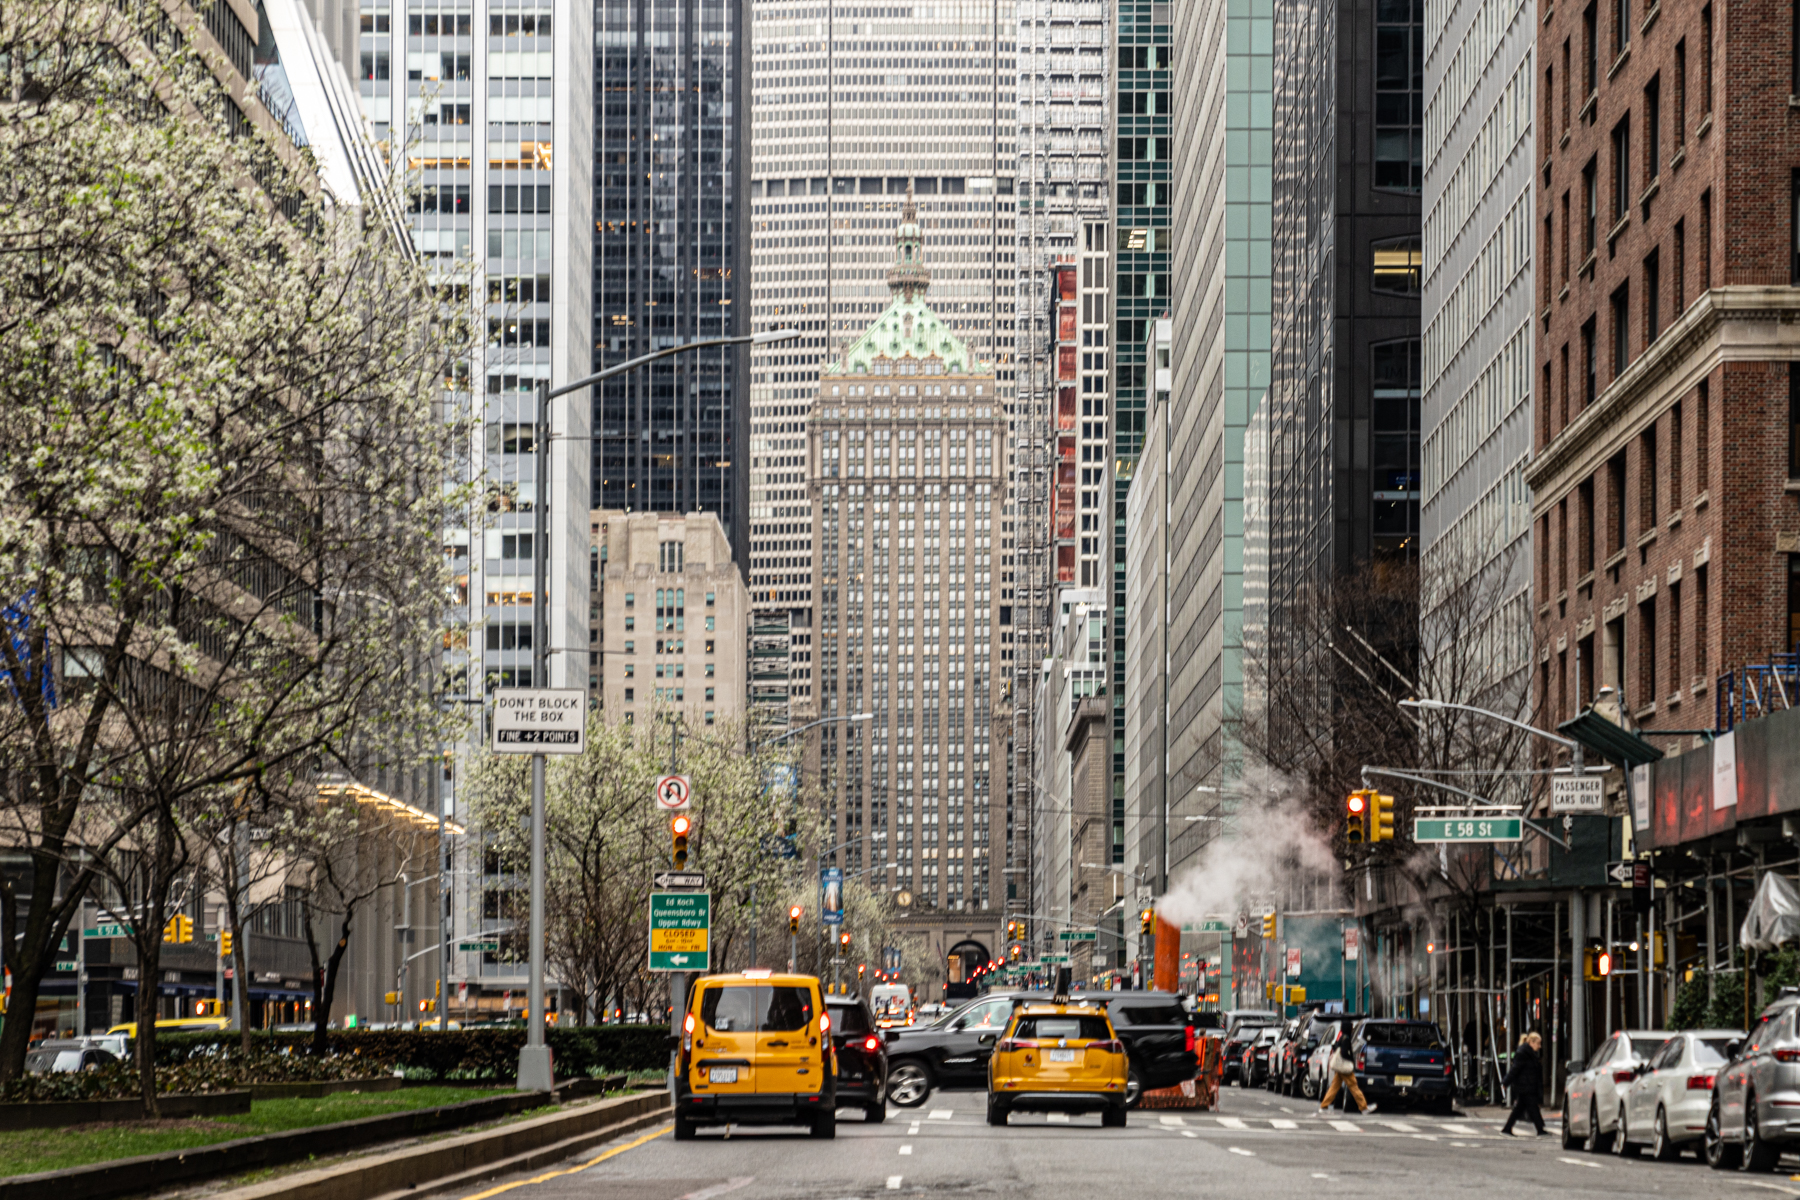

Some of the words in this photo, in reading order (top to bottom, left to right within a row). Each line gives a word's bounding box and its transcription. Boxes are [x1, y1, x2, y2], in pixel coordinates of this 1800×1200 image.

[499, 697, 535, 709] DON'T
[538, 697, 578, 709] BLOCK
[514, 711, 536, 722] THE
[540, 711, 563, 722] BOX
[500, 730, 521, 742] FINE
[542, 730, 576, 743] POINTS
[1555, 781, 1600, 792] PASSENGER
[1555, 794, 1576, 805] CARS
[1580, 794, 1600, 805] ONLY
[1444, 822, 1453, 837] E
[1457, 822, 1474, 837] 58
[1478, 821, 1492, 837] St
[660, 877, 675, 885] ONE
[684, 877, 700, 886] WAY
[666, 898, 674, 906] Ed
[677, 898, 694, 906] Koch
[654, 908, 696, 917] Queensboro
[698, 908, 706, 917] Br
[658, 919, 679, 929] Upper
[681, 919, 702, 929] Rdwy
[664, 930, 695, 938] CLOSED
[875, 995, 905, 1006] FedEx
